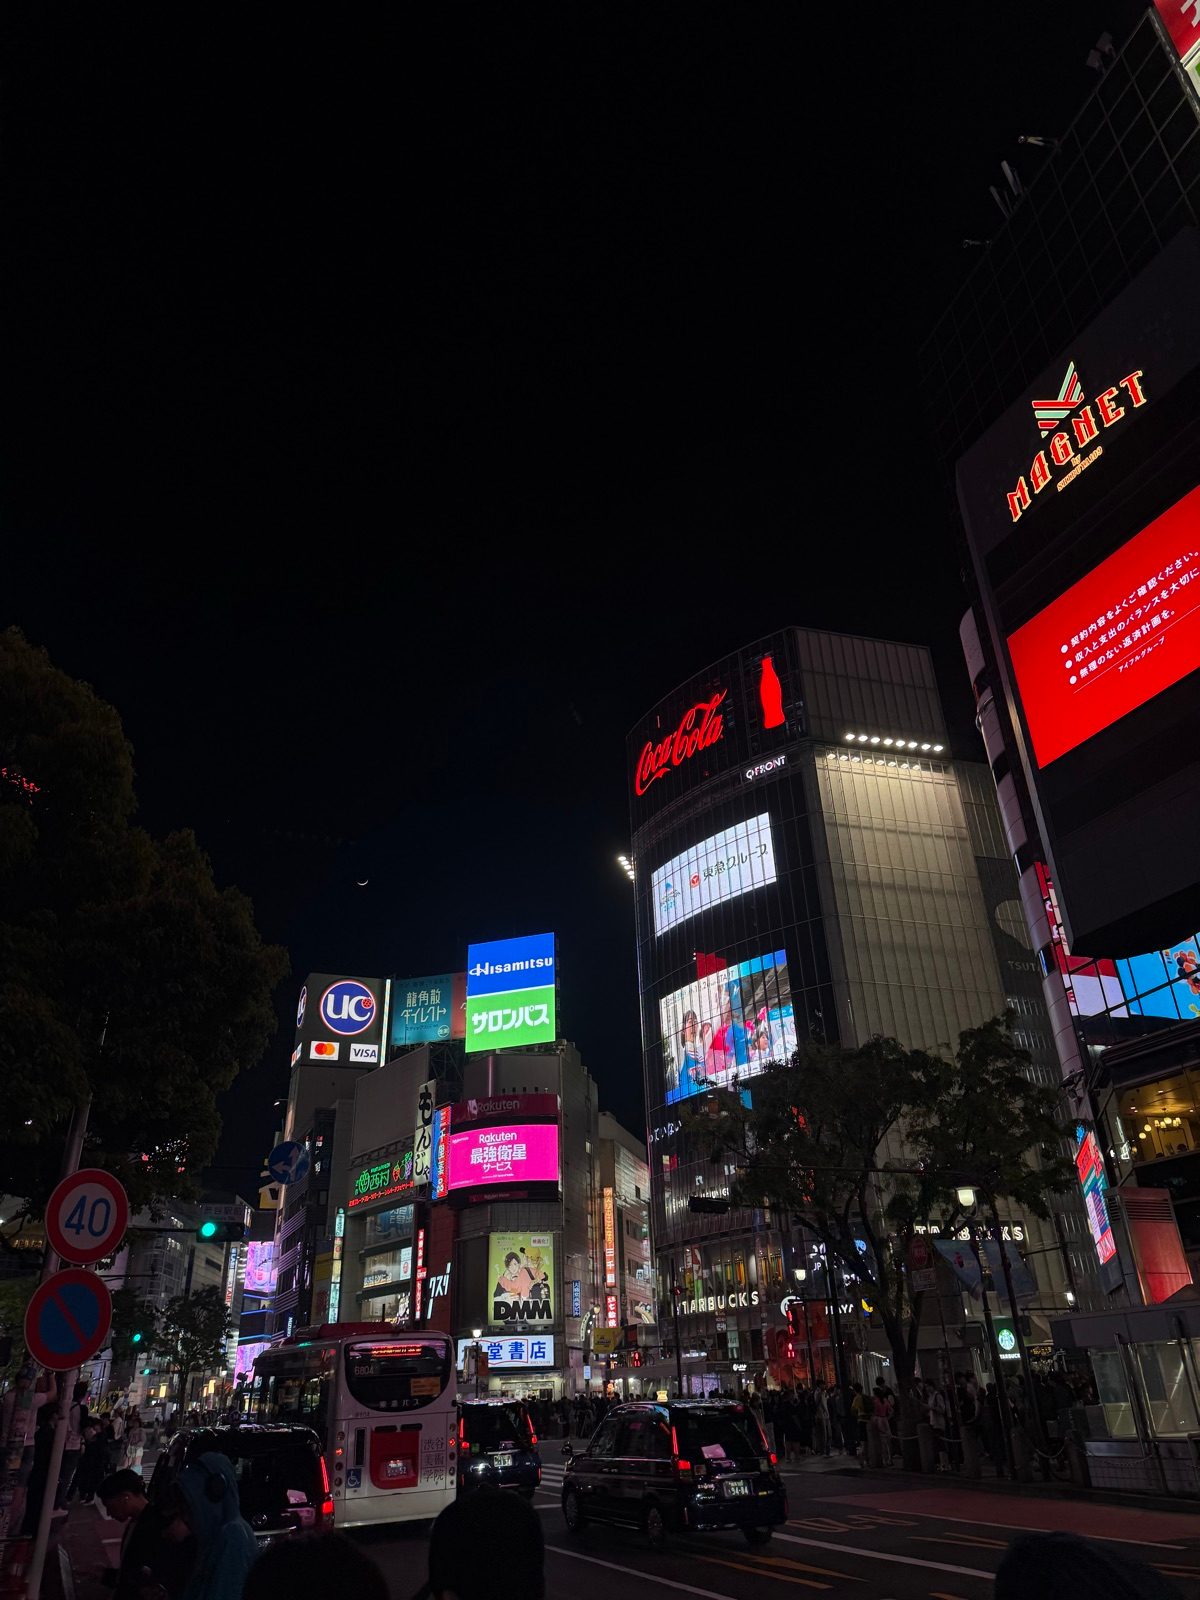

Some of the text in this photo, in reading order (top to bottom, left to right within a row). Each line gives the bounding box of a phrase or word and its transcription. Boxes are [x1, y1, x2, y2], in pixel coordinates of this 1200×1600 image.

[1007, 370, 1147, 522] MAGNET
[635, 687, 727, 797] Coca-Cola
[746, 755, 785, 781] QFRONT
[703, 843, 768, 882] 東急グループ
[469, 957, 553, 976] Hisamitsu
[406, 988, 441, 1008] 龍角散
[401, 1005, 447, 1025] ダイレクト
[472, 1004, 549, 1034] サロンパス
[352, 1048, 377, 1059] VISA
[477, 1100, 520, 1114] Rakuten
[415, 1085, 433, 1181] もんじゃ
[478, 1132, 518, 1145] Rakuten
[470, 1143, 527, 1165] 最強衛星
[482, 1161, 513, 1173] サービス
[64, 1195, 111, 1237] 40
[494, 1300, 552, 1321] DMM
